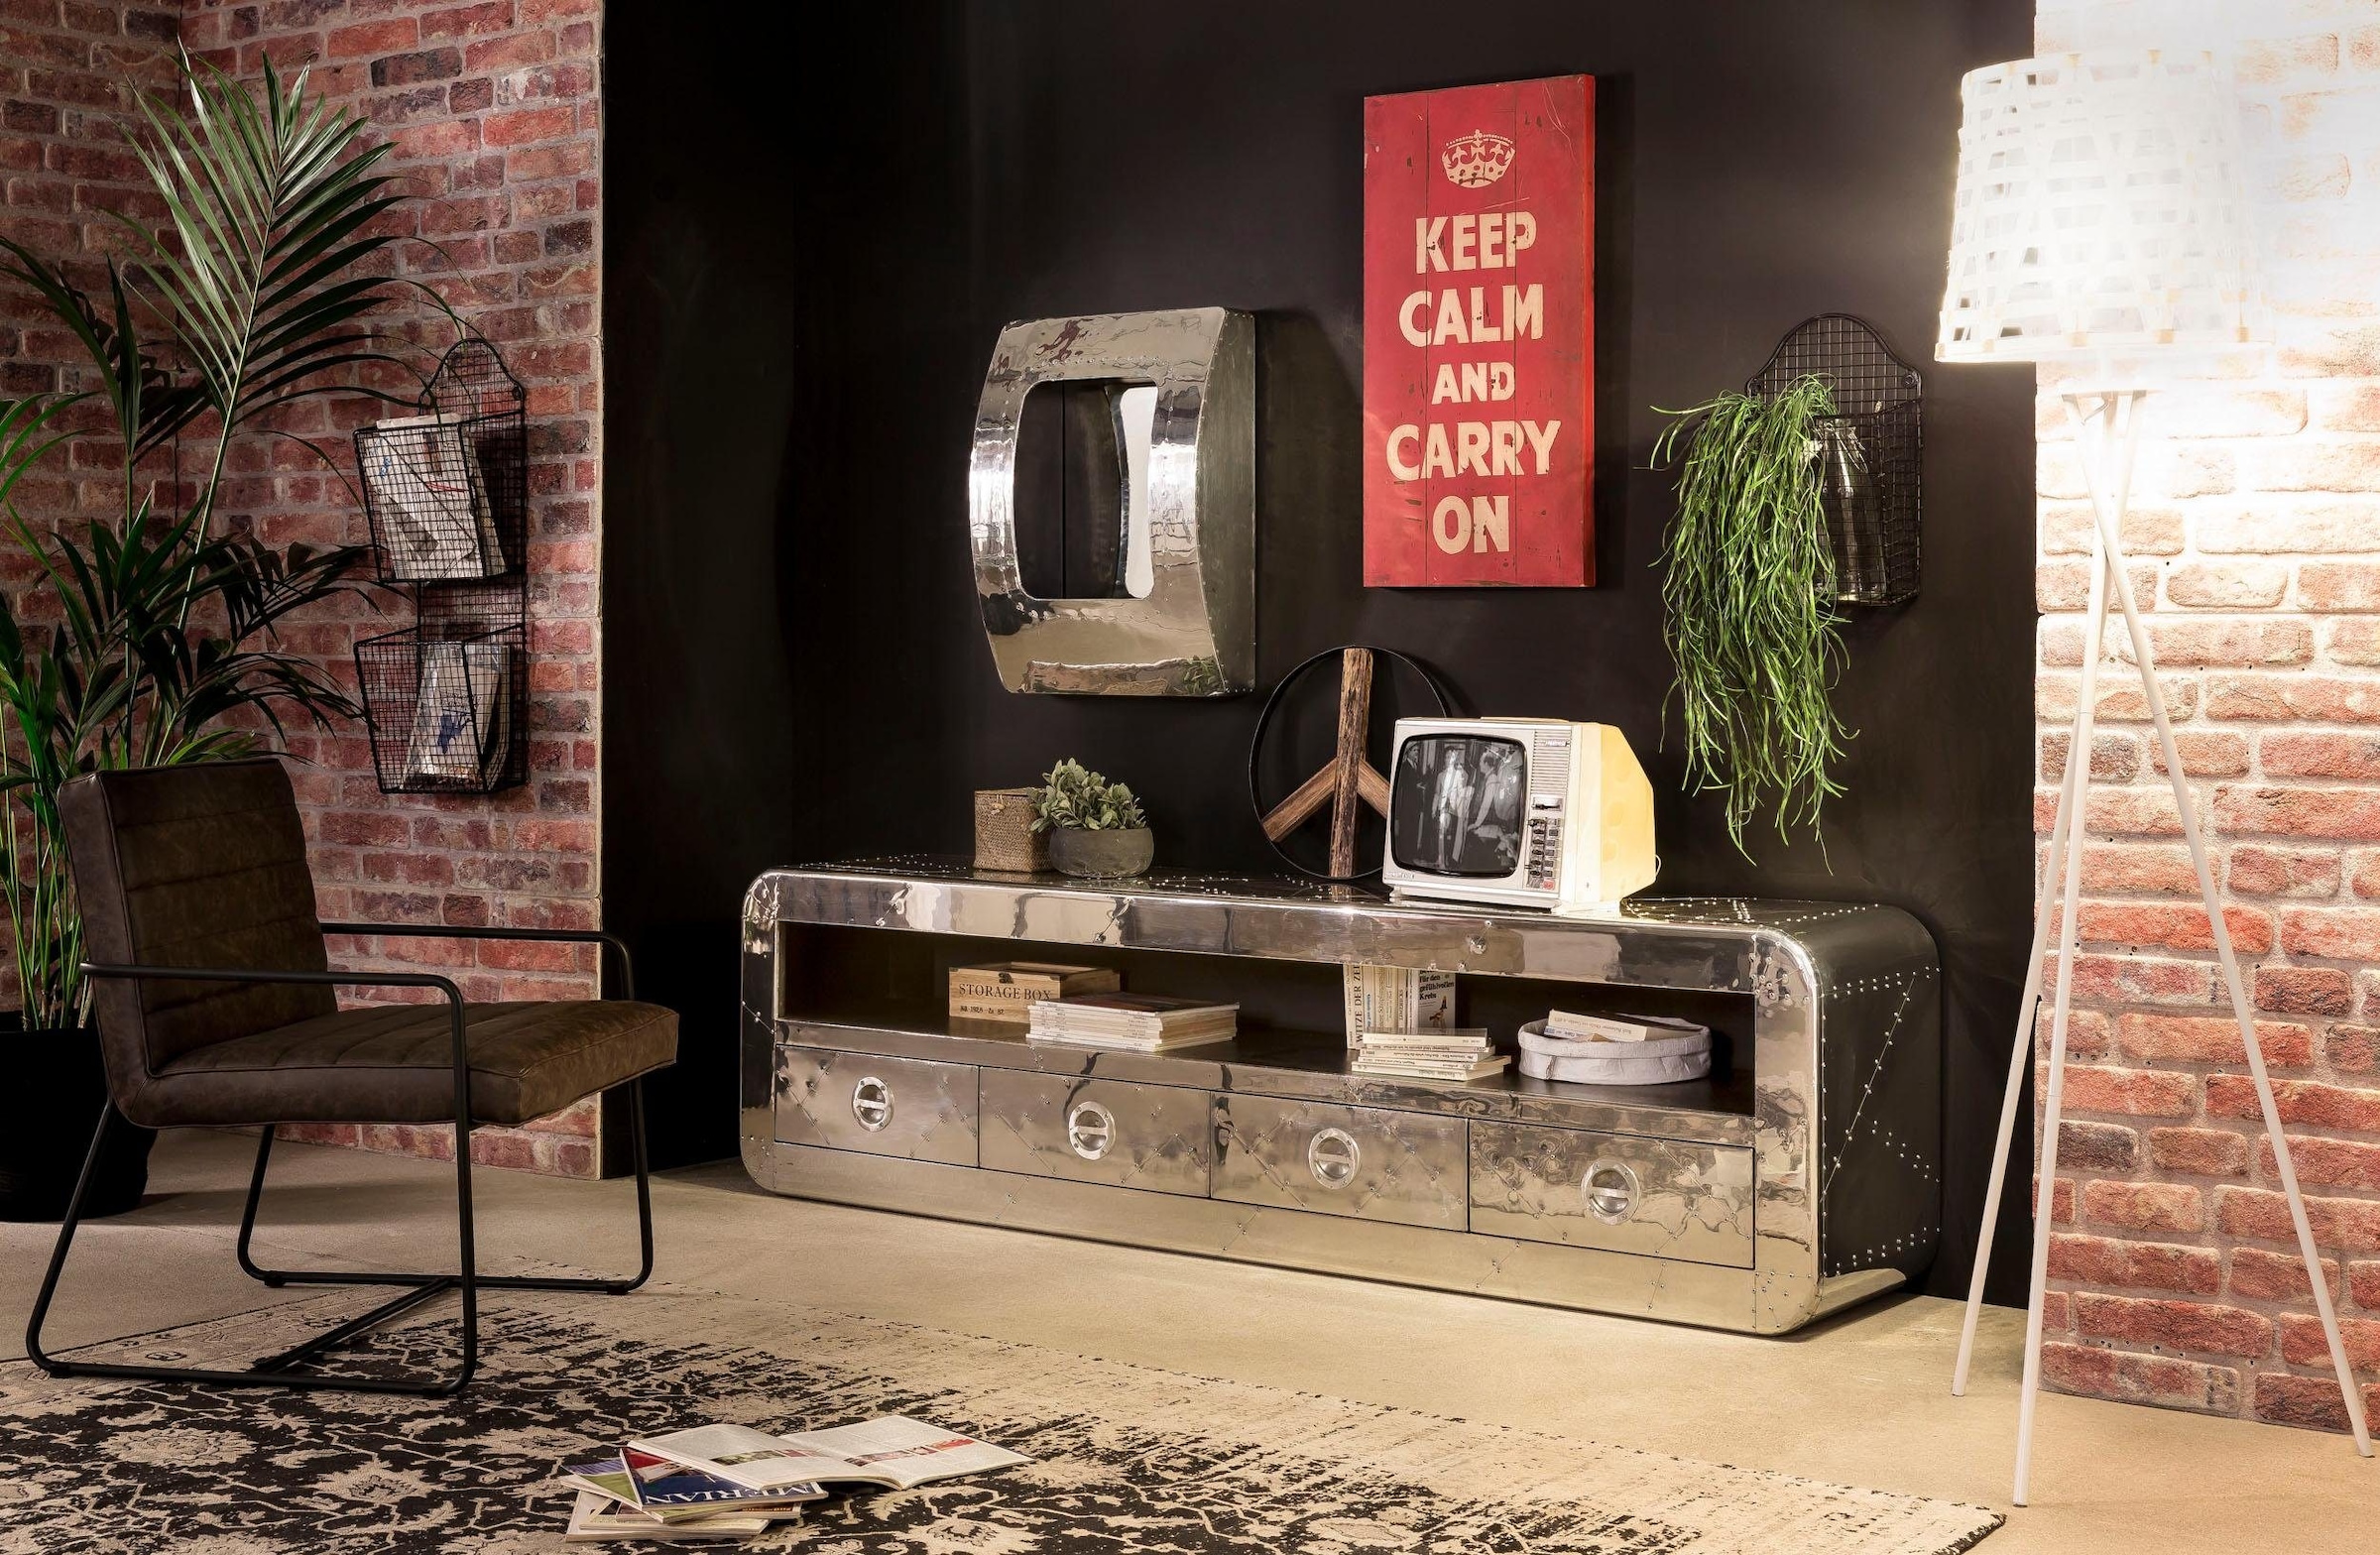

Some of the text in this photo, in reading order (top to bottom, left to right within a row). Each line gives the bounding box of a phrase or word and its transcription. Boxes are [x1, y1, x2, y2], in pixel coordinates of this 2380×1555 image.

[1416, 210, 1537, 274] KEEP
[1398, 283, 1544, 348] CALM
[1431, 361, 1515, 406] AND
[1386, 419, 1562, 482] CARRY
[1432, 495, 1510, 555] ON
[959, 983, 1051, 1001] STORAGE BOX
[1354, 986, 1363, 1007] DER
[1355, 1011, 1364, 1042] WITZE
[645, 1483, 810, 1503] MERIAN
